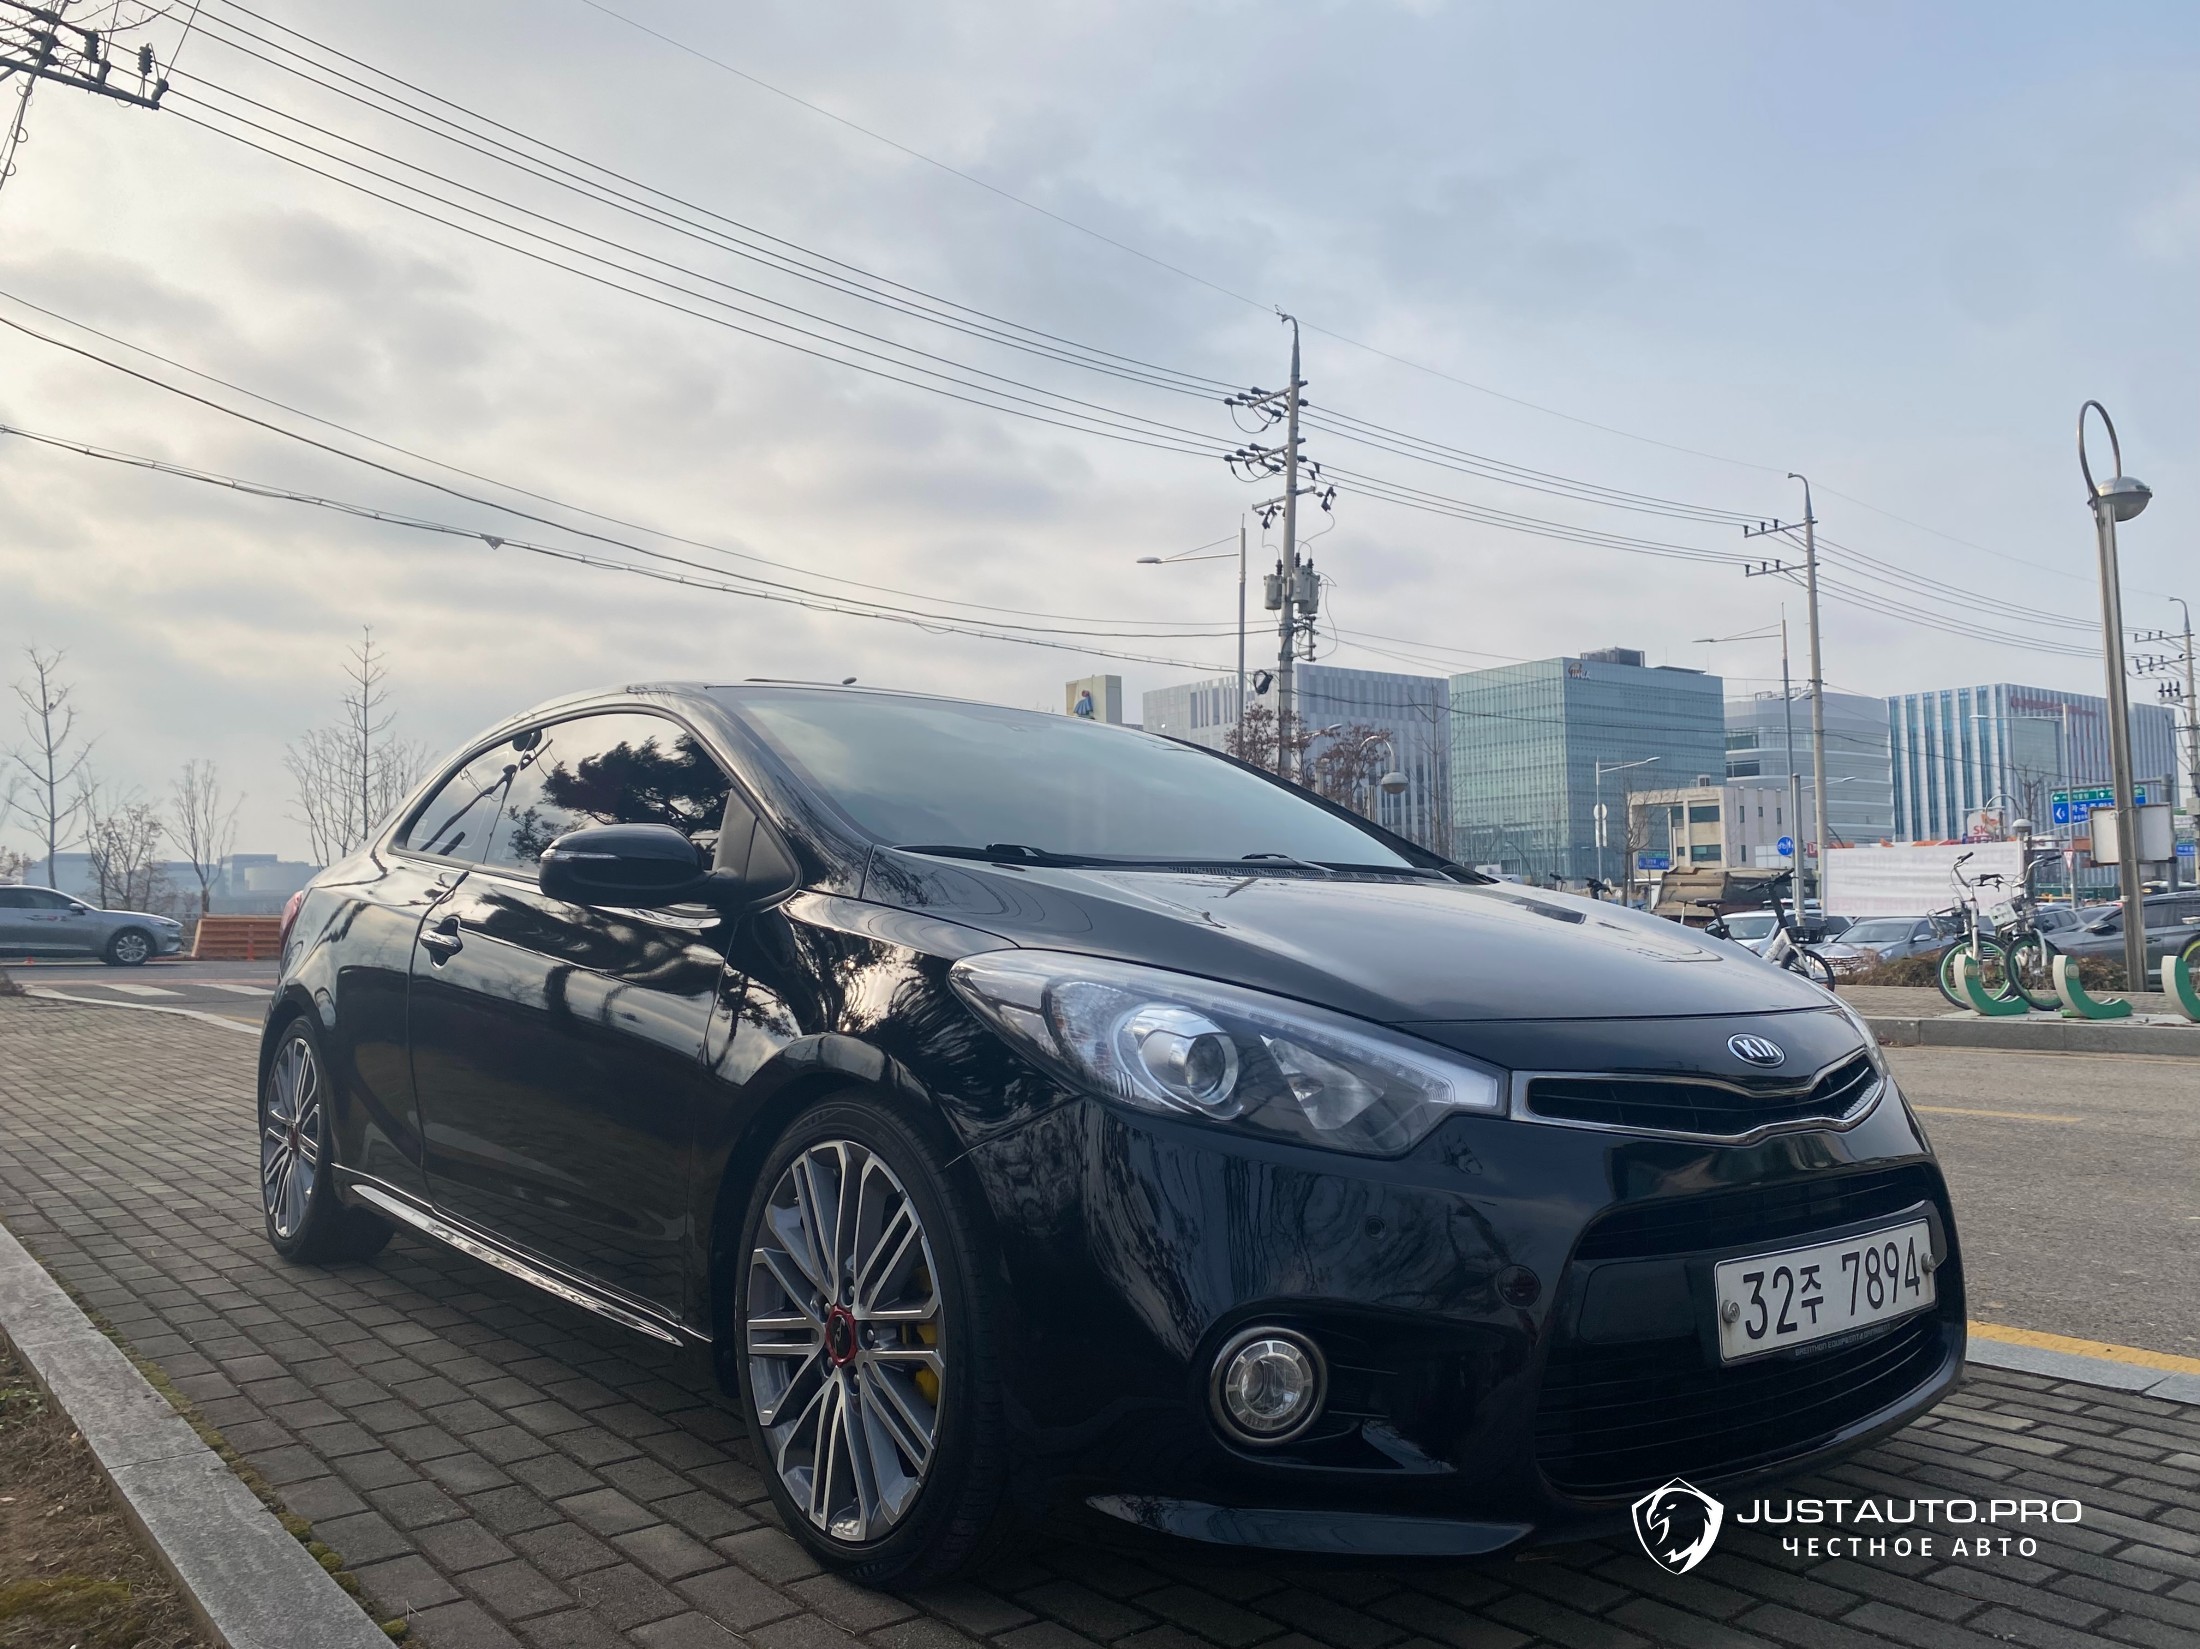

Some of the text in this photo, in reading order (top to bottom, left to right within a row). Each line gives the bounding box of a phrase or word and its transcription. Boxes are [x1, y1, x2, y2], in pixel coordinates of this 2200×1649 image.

[1735, 1038, 1781, 1058] KIA
[1742, 1235, 1921, 1340] 32주 7894
